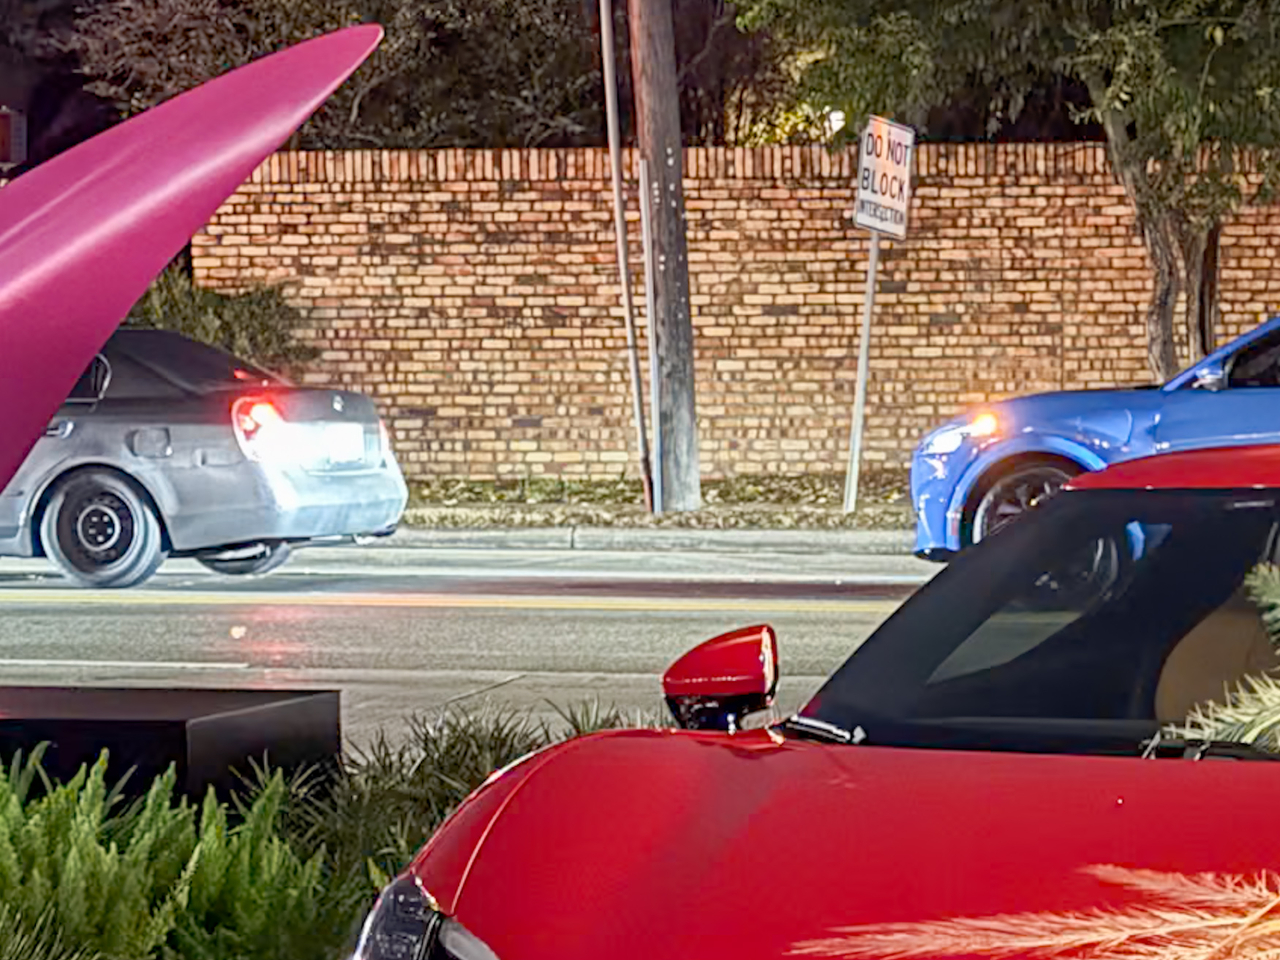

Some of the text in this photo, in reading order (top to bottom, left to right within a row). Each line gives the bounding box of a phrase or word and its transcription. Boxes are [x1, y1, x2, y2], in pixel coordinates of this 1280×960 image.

[866, 133, 909, 167] DO NOT
[861, 167, 906, 203] BLOCK
